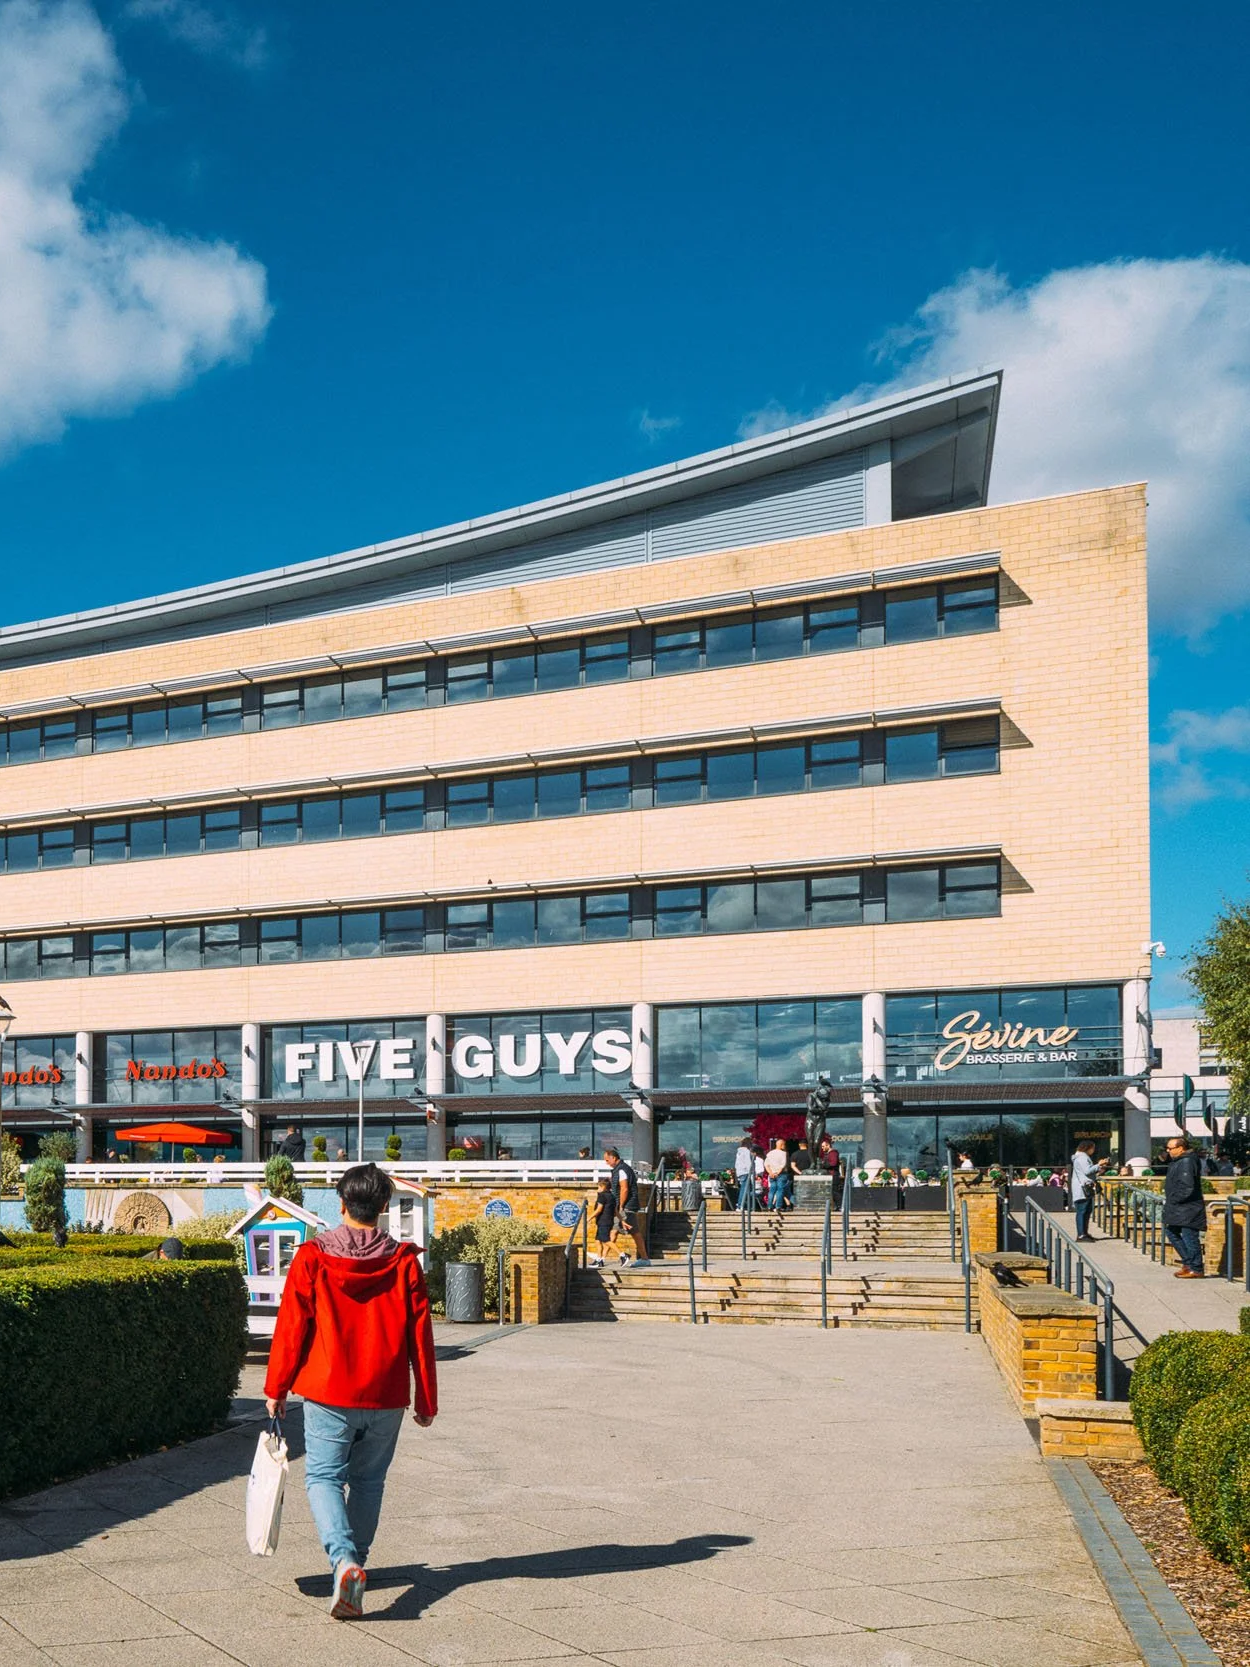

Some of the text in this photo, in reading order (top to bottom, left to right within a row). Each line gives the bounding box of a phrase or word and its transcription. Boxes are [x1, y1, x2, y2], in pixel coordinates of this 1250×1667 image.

[285, 1029, 633, 1083] FIVE GUYS
[934, 1010, 1078, 1071] Sévine
[966, 1051, 1078, 1064] BRASSERIE & BAR
[125, 1058, 227, 1081] Nando's
